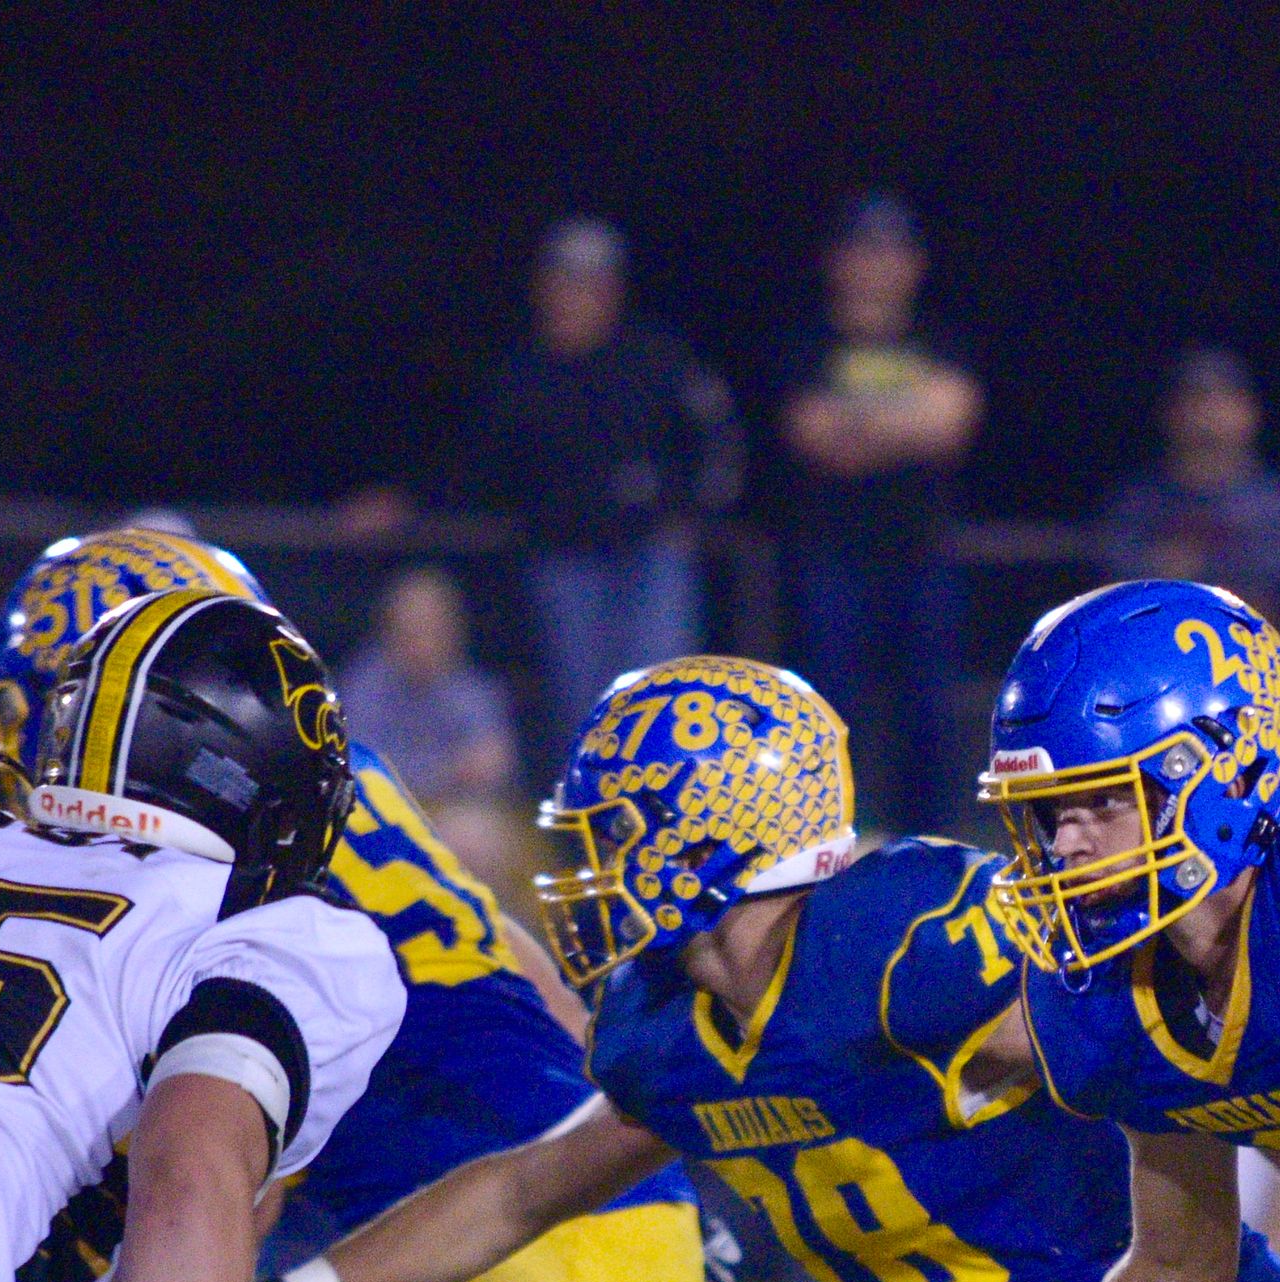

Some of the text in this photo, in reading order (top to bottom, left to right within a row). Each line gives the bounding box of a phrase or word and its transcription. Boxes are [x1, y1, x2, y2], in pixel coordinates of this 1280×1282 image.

[1174, 618, 1246, 687] 2
[620, 690, 719, 761] 78
[994, 754, 1038, 774] Riddell
[40, 792, 162, 833] Riddell
[691, 1095, 835, 1151] INDIANS
